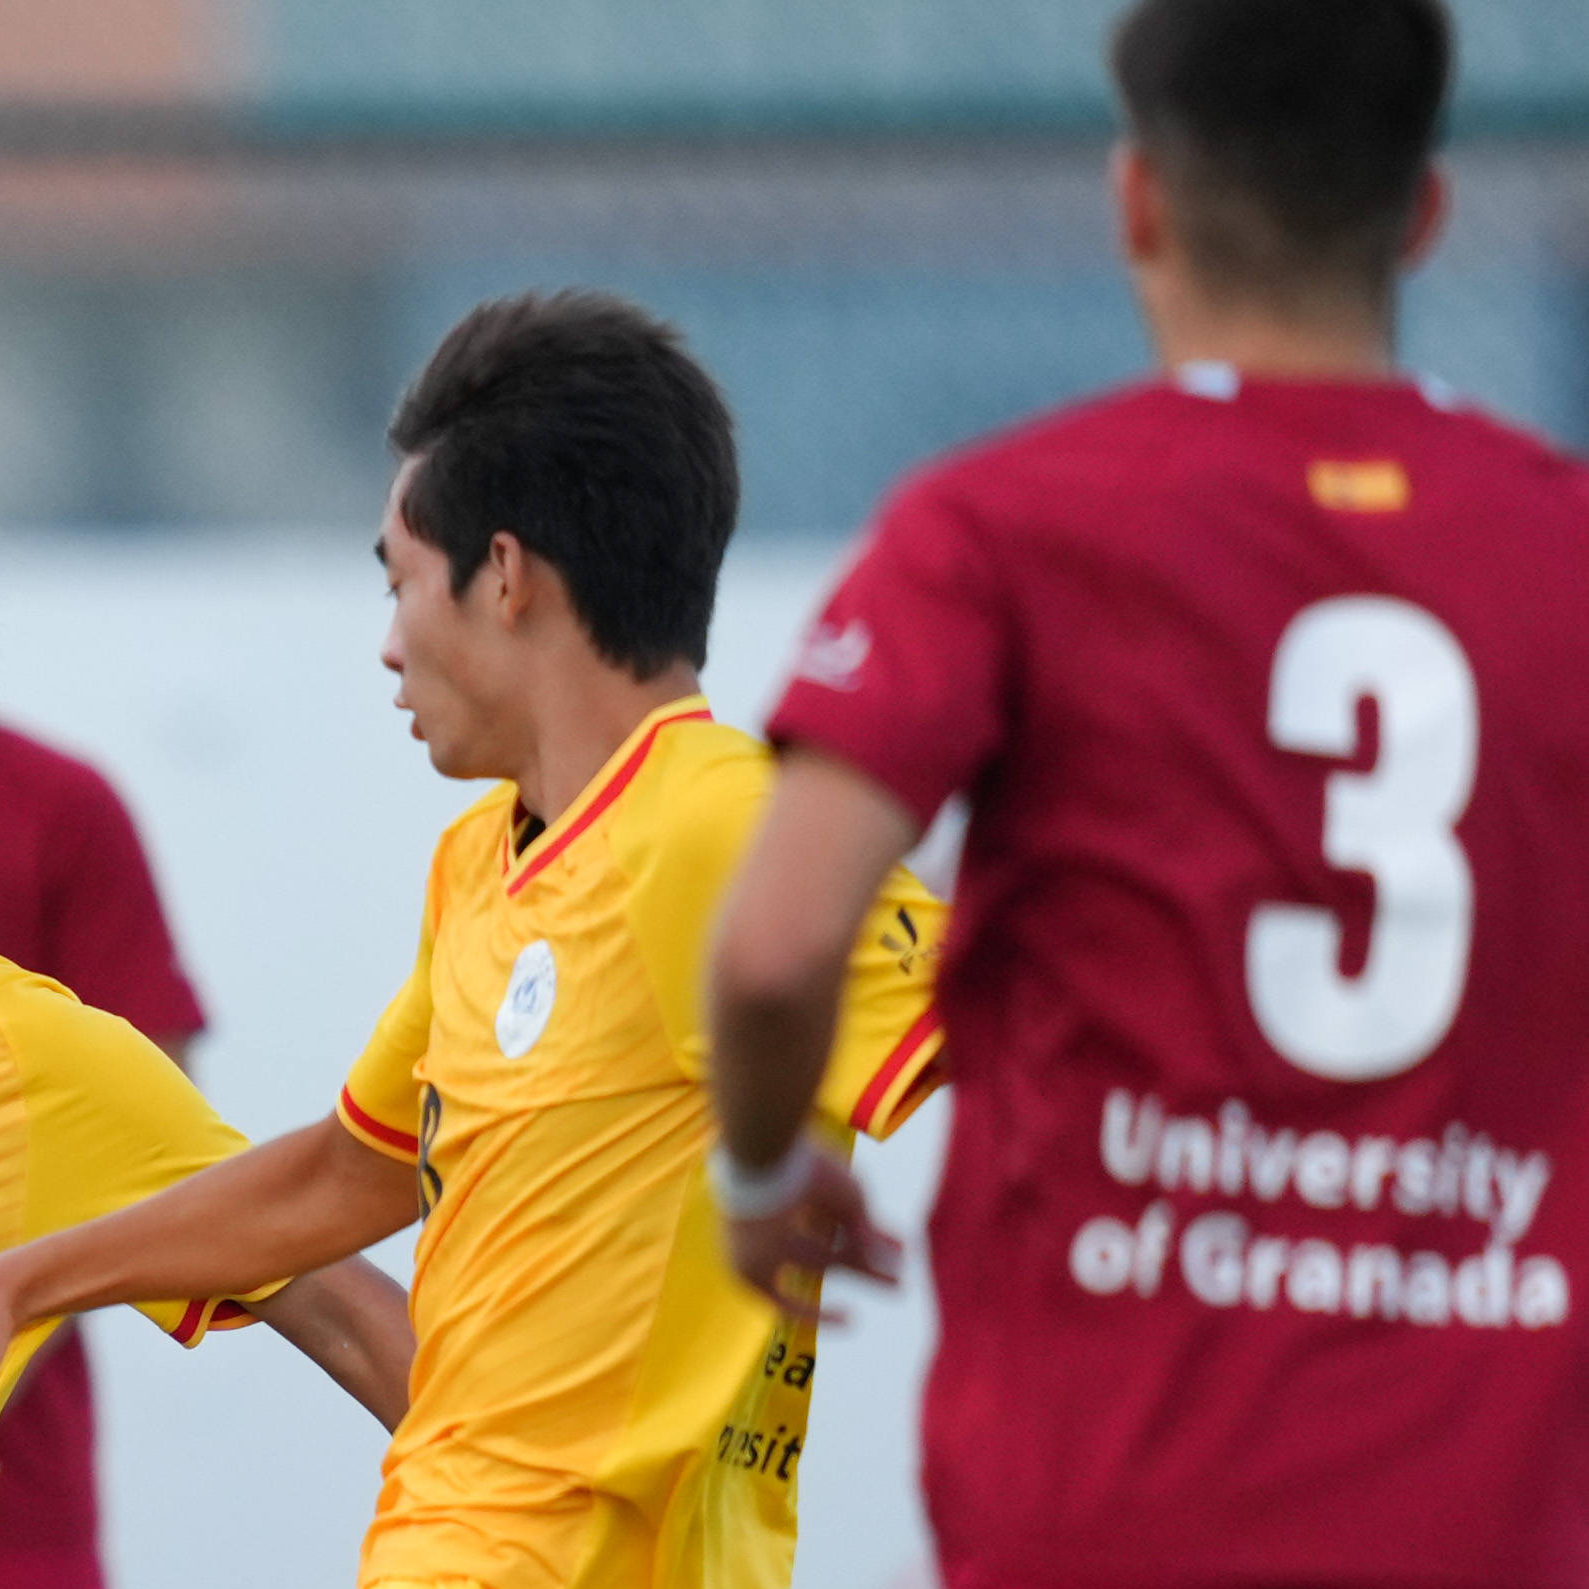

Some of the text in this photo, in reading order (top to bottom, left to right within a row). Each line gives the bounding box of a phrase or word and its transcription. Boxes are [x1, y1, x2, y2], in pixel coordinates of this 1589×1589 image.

[1245, 595, 1478, 1082] 3
[1100, 1087, 1549, 1241] University
[1069, 1202, 1568, 1329] of Granada
